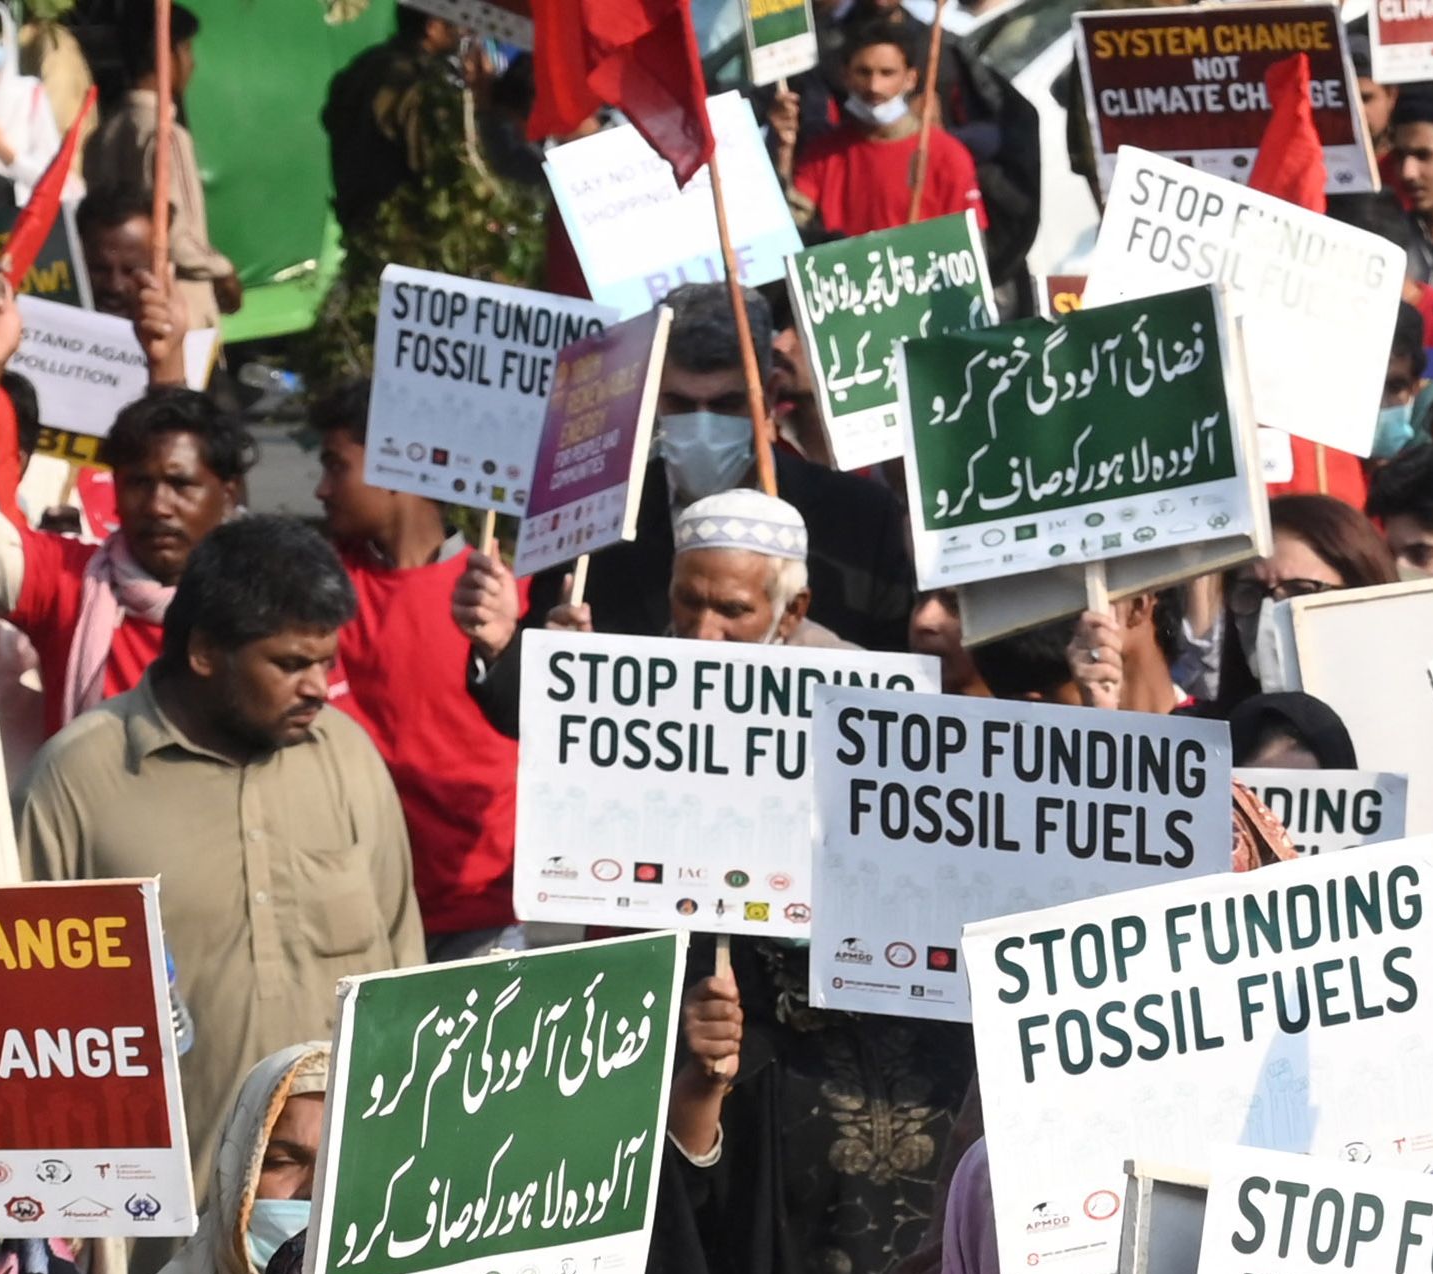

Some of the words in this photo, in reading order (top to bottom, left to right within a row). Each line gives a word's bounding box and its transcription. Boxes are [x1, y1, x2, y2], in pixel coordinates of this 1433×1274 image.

[1093, 24, 1200, 61] SYSTEM
[1207, 21, 1332, 54] CHANGE
[1193, 55, 1239, 82] NOT
[1100, 83, 1221, 118] CLIMATE
[1129, 168, 1224, 228] STOP
[391, 281, 468, 329] STOP
[396, 331, 493, 389] FOSSIL
[929, 349, 988, 425] کرو
[987, 336, 1032, 439] ختم
[1025, 325, 1123, 416] آلودگی
[1125, 314, 1206, 397] فضائی
[933, 443, 990, 519] کرو
[547, 650, 677, 707] STOP
[558, 713, 729, 777] FOSSIL
[835, 706, 968, 775] STOP
[982, 720, 1207, 799] FUNDING
[848, 778, 1021, 854] FOSSIL
[1035, 795, 1196, 871] FUELS
[996, 914, 1147, 1005] STOP
[1165, 864, 1423, 972] FUNDING
[463, 976, 573, 1114] آلودگی
[558, 972, 655, 1097] فضائی
[1018, 988, 1225, 1085] FOSSIL
[1238, 945, 1419, 1043] FUELS
[362, 1005, 440, 1120] کرو
[421, 989, 479, 1149] ختم
[337, 1155, 415, 1268] کرو
[387, 1177, 473, 1259] صاف
[1229, 1175, 1386, 1271] STOP
